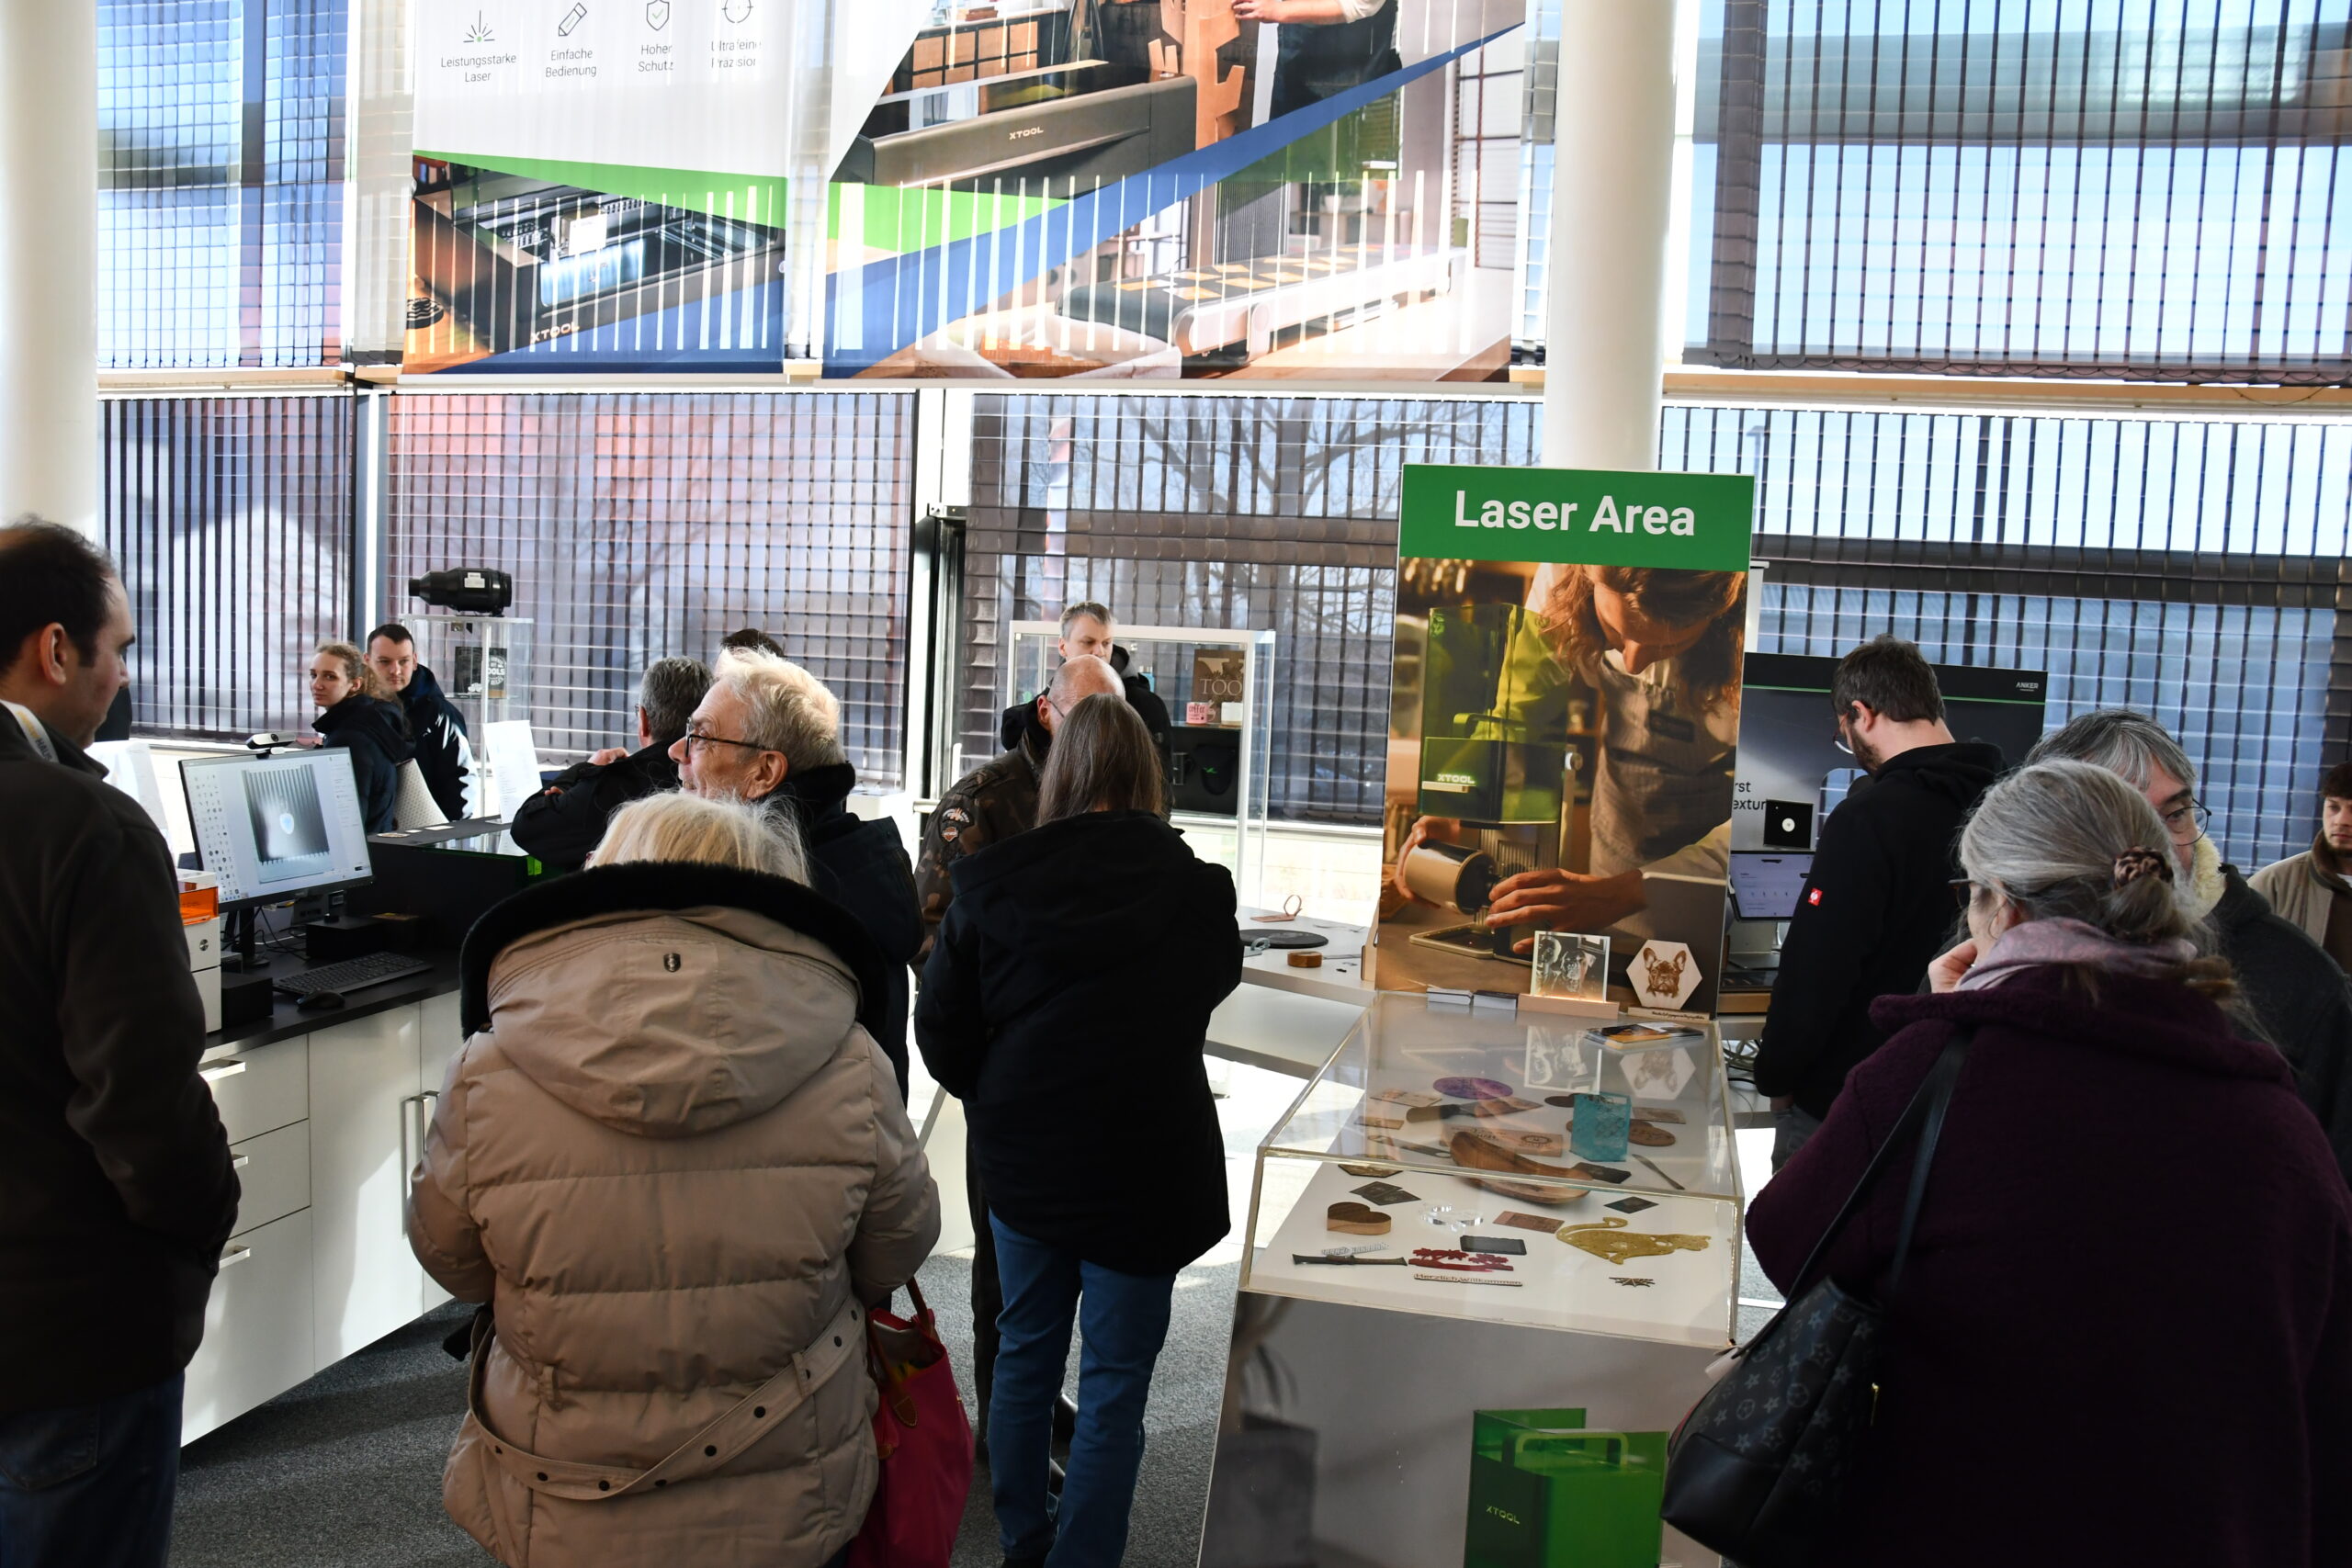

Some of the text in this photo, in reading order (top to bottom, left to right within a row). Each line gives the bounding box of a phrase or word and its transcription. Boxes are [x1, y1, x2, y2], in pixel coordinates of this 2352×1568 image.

[550, 48, 594, 62] Einfache
[640, 43, 673, 56] Hoher
[440, 52, 517, 69] Leistungsstarke
[464, 71, 492, 83] Laser
[545, 64, 597, 78] Bedienung
[1009, 126, 1045, 141] XTOOL
[529, 321, 581, 345] XTOOL
[1454, 490, 1696, 536] Laser Area
[1199, 678, 1243, 696] TOO
[1437, 773, 1476, 784] XTOOL
[1732, 798, 1768, 810] extur
[1486, 1505, 1521, 1525] XTOOL
